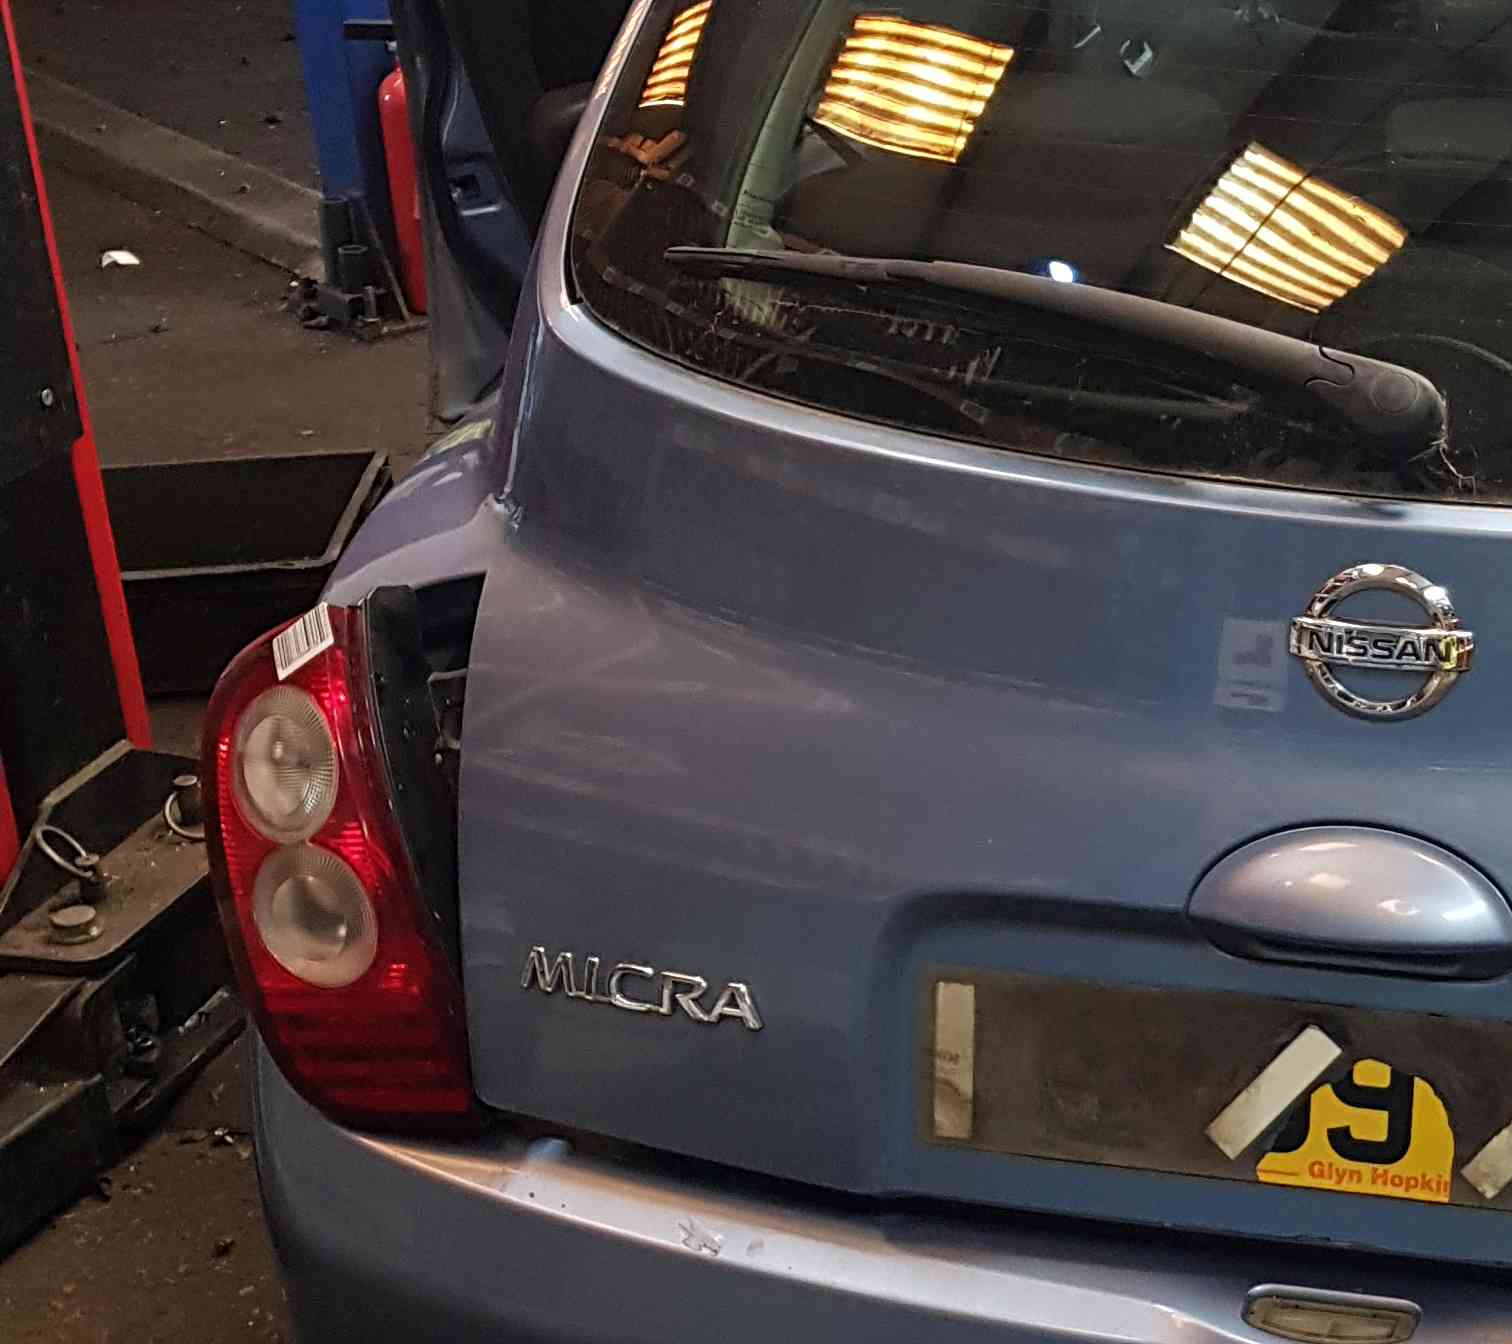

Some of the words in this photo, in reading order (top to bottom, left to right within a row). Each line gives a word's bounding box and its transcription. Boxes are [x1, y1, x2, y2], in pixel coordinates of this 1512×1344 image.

[1307, 629, 1455, 664] NISSAN
[520, 945, 764, 1031] MICRA
[1271, 1059, 1416, 1166] 9
[1307, 1160, 1363, 1186] Glyn
